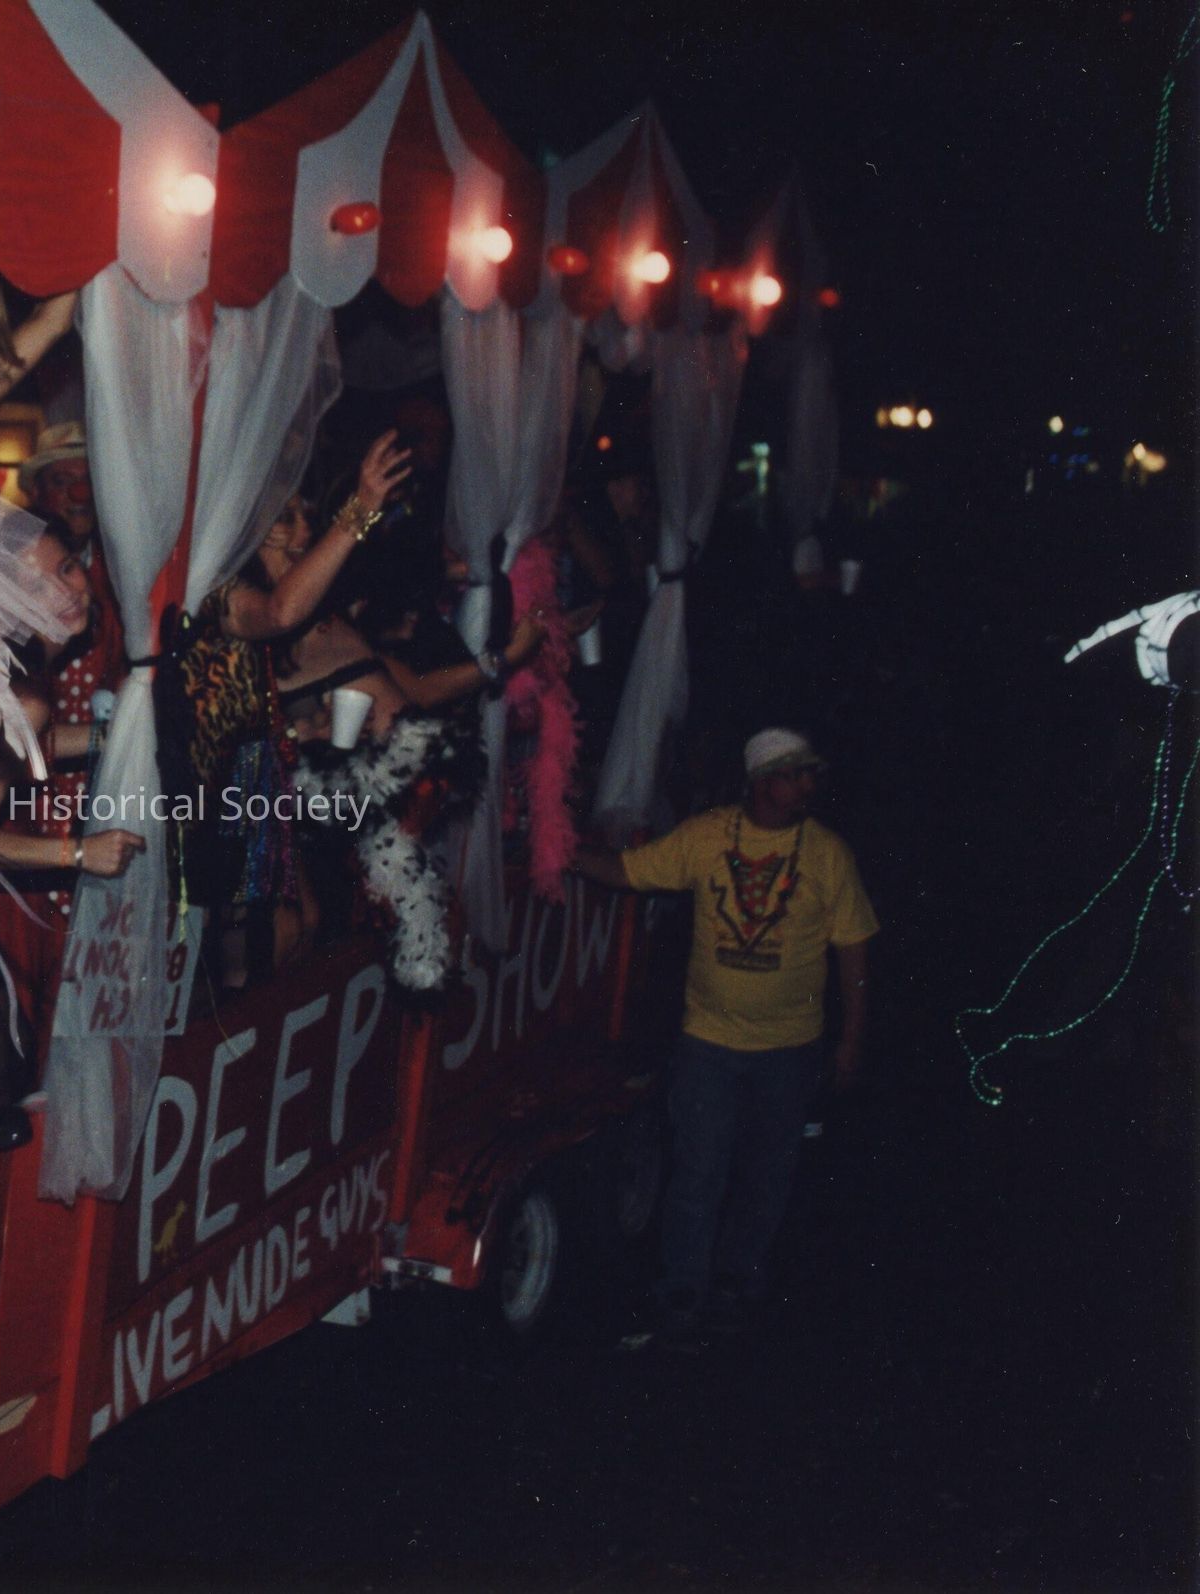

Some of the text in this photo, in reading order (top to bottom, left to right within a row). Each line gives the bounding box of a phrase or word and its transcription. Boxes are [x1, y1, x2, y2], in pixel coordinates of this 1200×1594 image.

[137, 872, 618, 1285] PEEP SHOW
[201, 1206, 312, 1364] NUDE
[319, 1149, 391, 1252] GUYS
